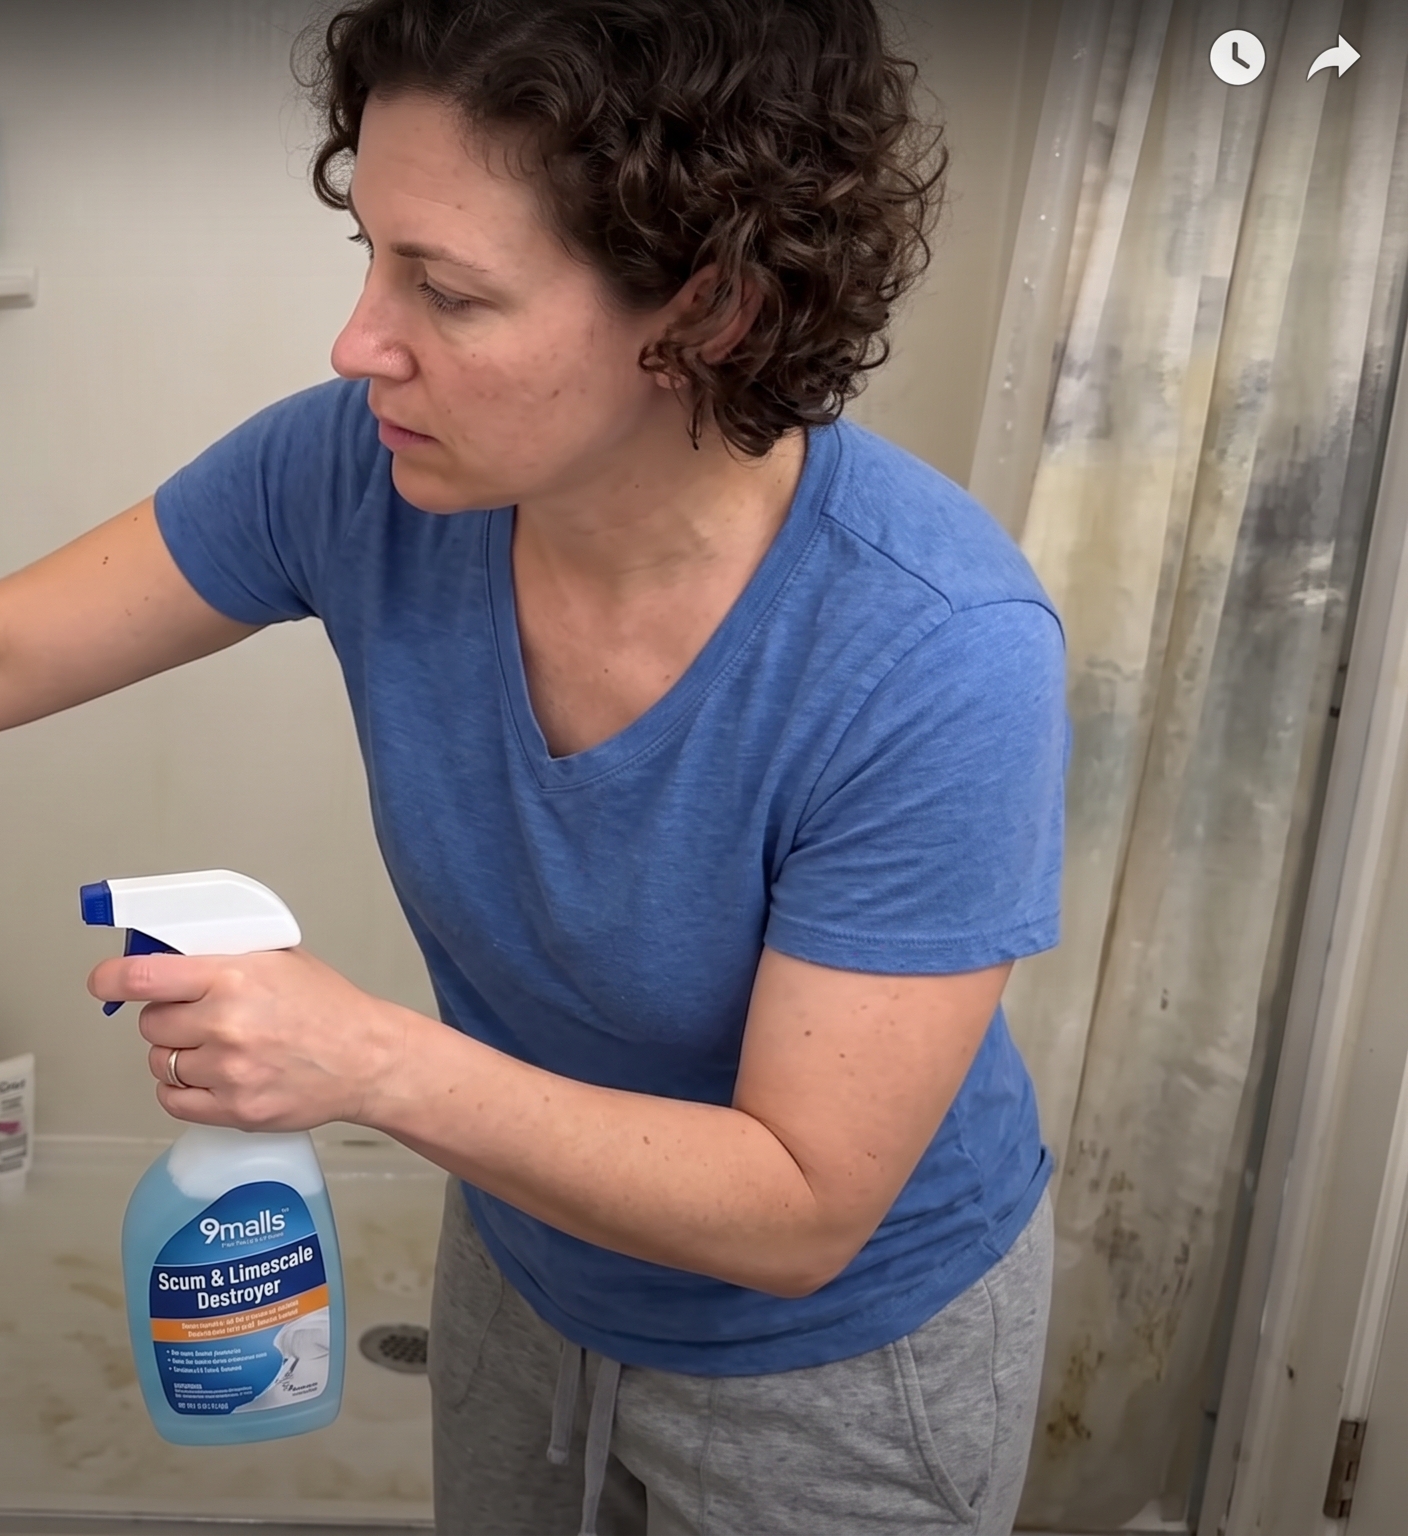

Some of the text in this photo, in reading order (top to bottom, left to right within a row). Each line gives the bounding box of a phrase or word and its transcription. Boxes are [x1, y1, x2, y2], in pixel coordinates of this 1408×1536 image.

[199, 1209, 286, 1245] 9malls
[158, 1245, 314, 1291] Scum & Limescale
[197, 1278, 282, 1310] Destroyer
